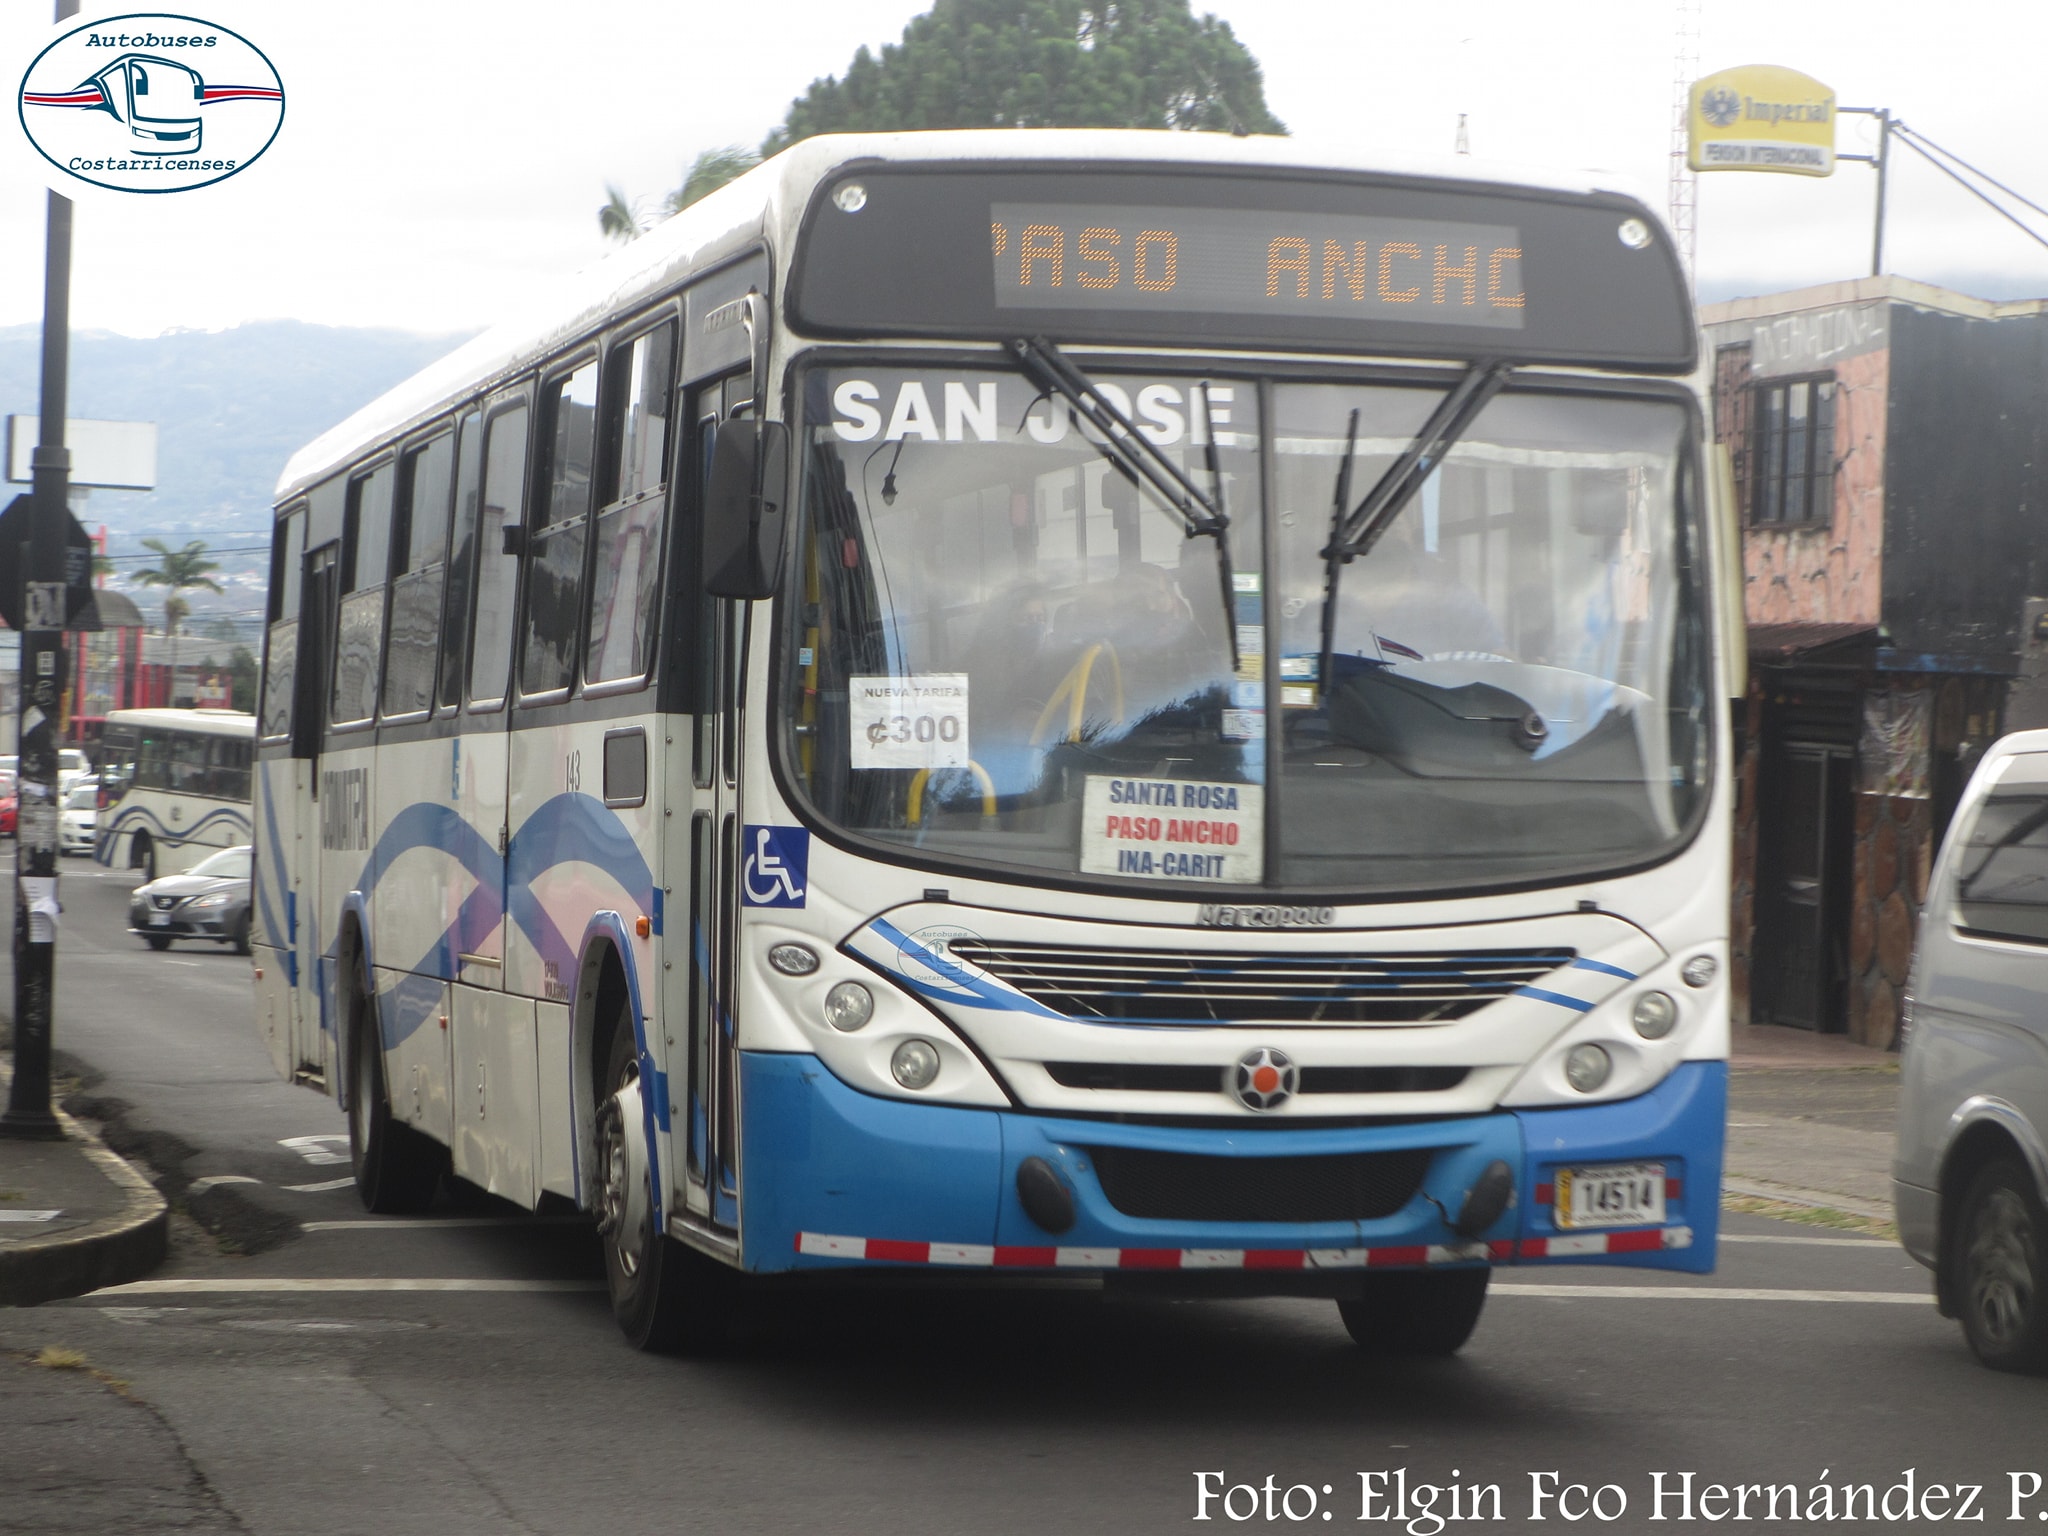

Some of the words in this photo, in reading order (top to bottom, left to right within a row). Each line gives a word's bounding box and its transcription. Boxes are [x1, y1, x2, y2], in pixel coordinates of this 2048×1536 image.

[1744, 96, 1835, 127] Imperial
[832, 380, 998, 441] SAN
[865, 688, 909, 697] NUEVA
[914, 688, 961, 696] TARIFA
[1110, 780, 1177, 807] SANTA
[1183, 785, 1239, 811] ROSA
[1106, 815, 1162, 841] PASO
[1166, 819, 1240, 846] ANCHO
[1119, 850, 1225, 878] INA-CARIT
